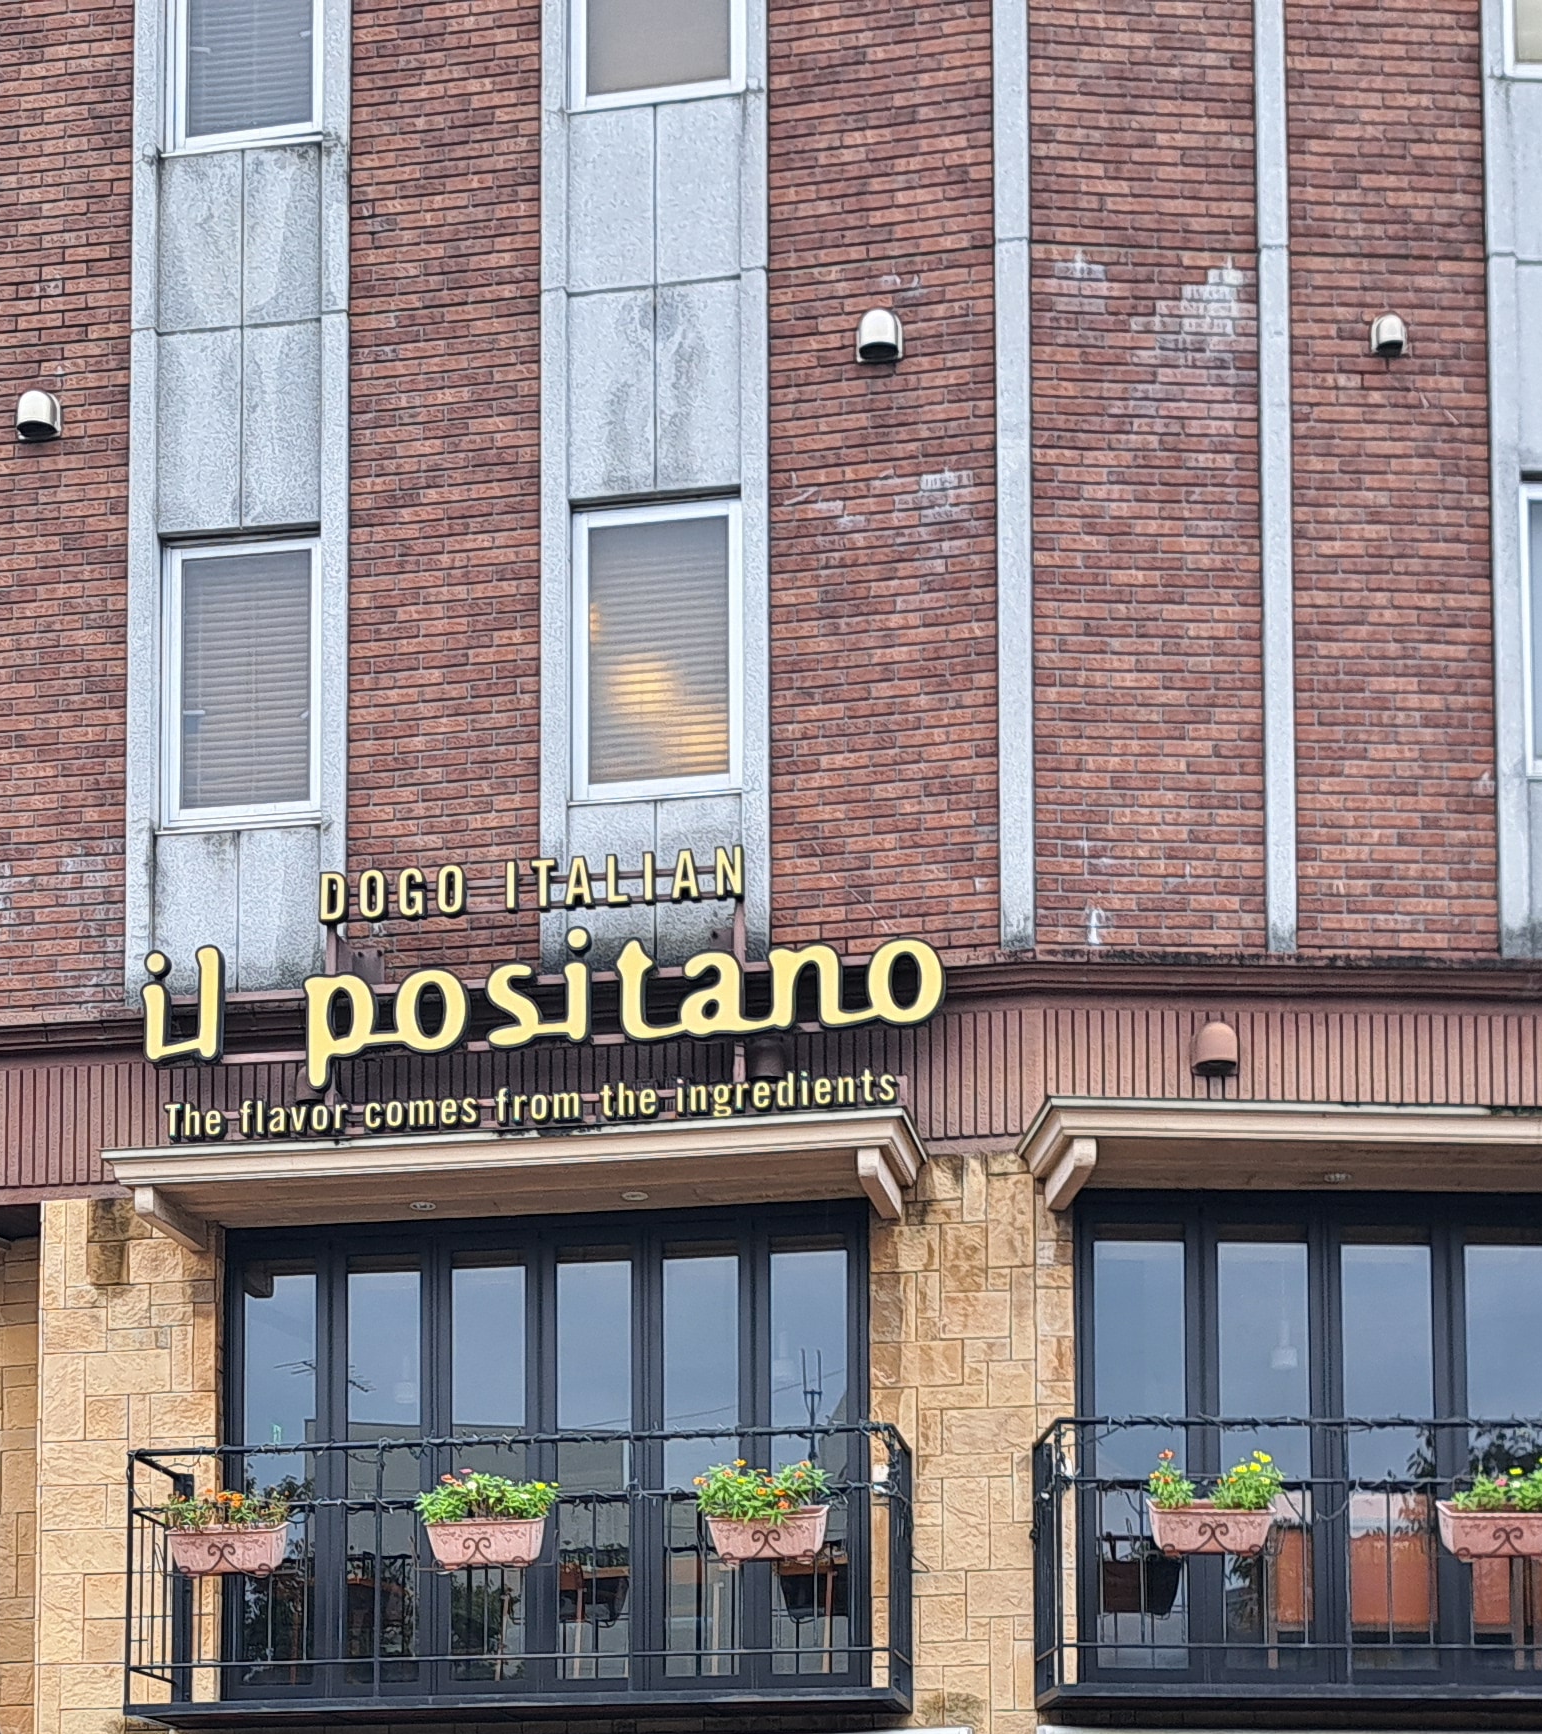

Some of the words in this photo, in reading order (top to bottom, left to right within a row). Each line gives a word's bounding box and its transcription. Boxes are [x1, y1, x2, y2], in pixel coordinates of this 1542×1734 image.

[319, 864, 466, 924] DOGO
[505, 845, 745, 911] ITALIAN
[142, 945, 225, 1064] il
[303, 926, 947, 1091] positano
[164, 1103, 224, 1138] The
[239, 1098, 348, 1135] flavor
[362, 1096, 479, 1129] comes
[495, 1087, 581, 1123] from
[600, 1081, 658, 1118] the
[674, 1068, 897, 1118] ingredients
